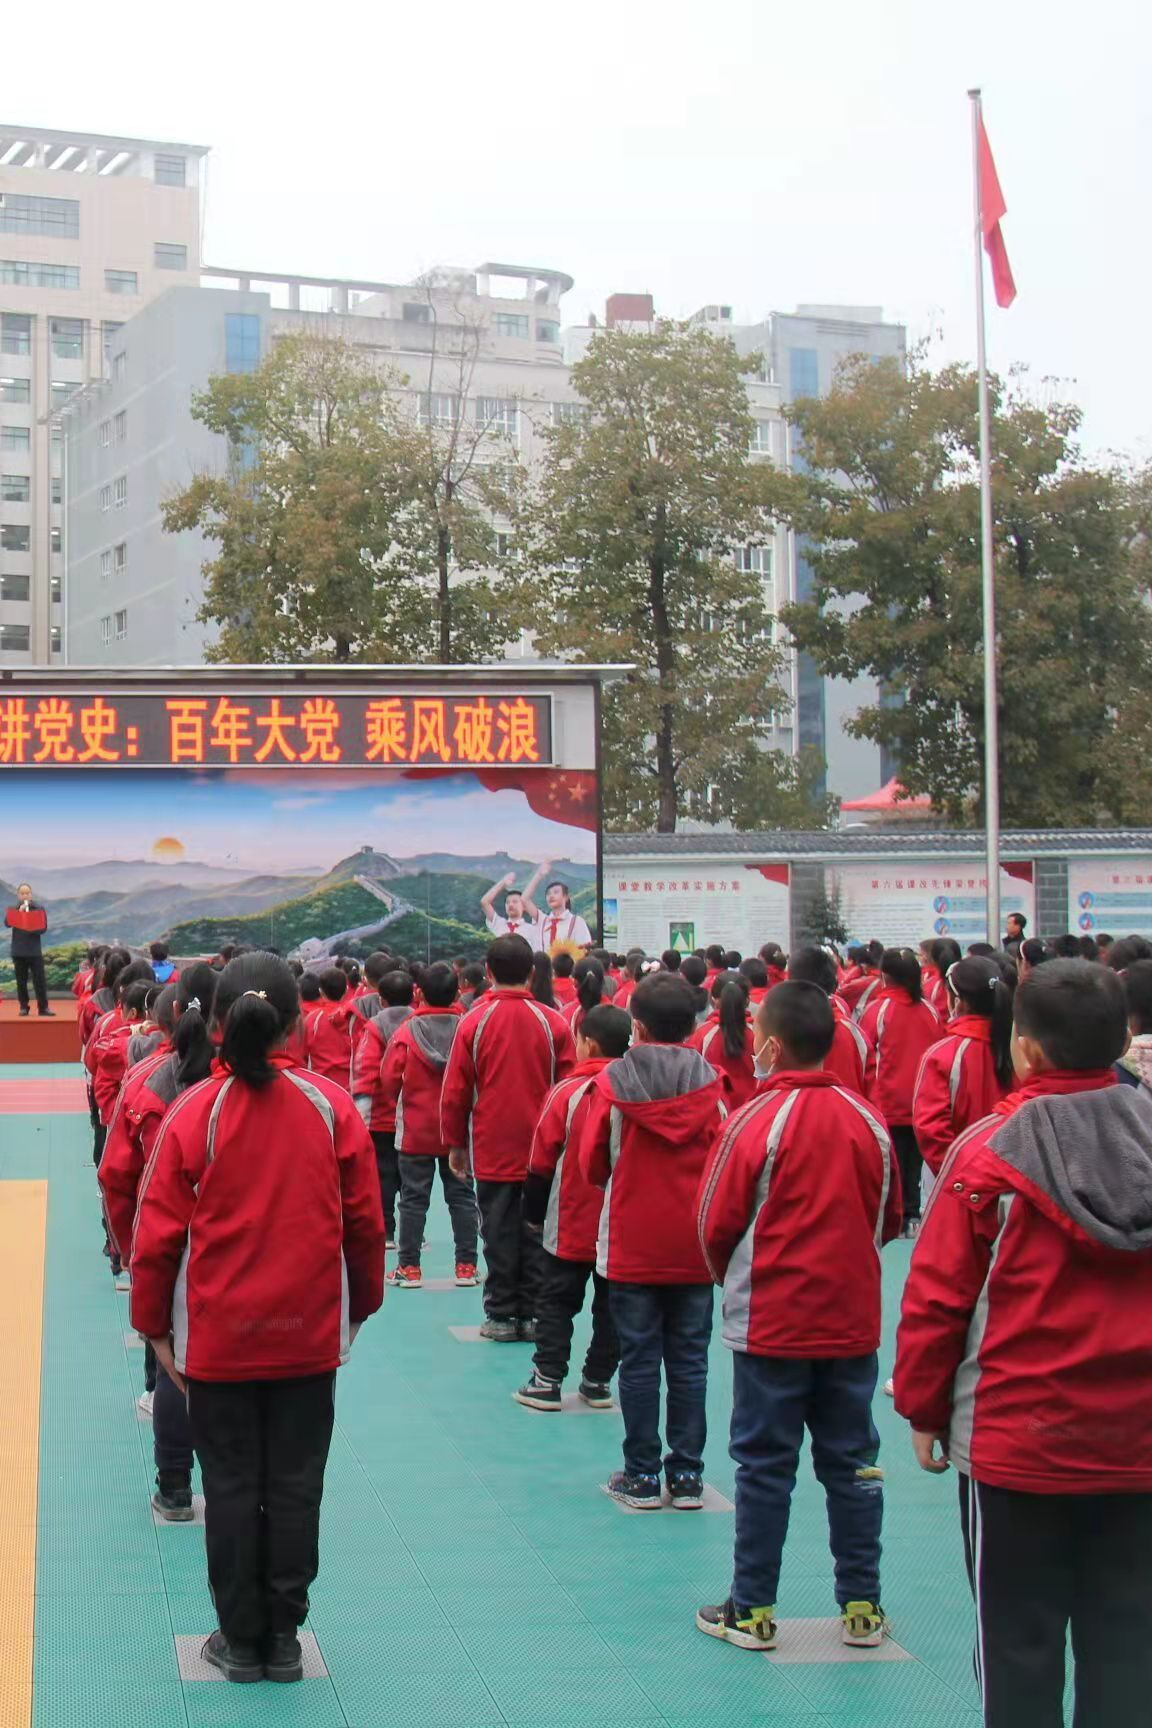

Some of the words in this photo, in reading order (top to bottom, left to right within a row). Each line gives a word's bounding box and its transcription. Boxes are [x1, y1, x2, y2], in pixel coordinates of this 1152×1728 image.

[365, 696, 540, 764] 乘风破浪
[617, 881, 741, 892] 课堂教学改革实施方案
